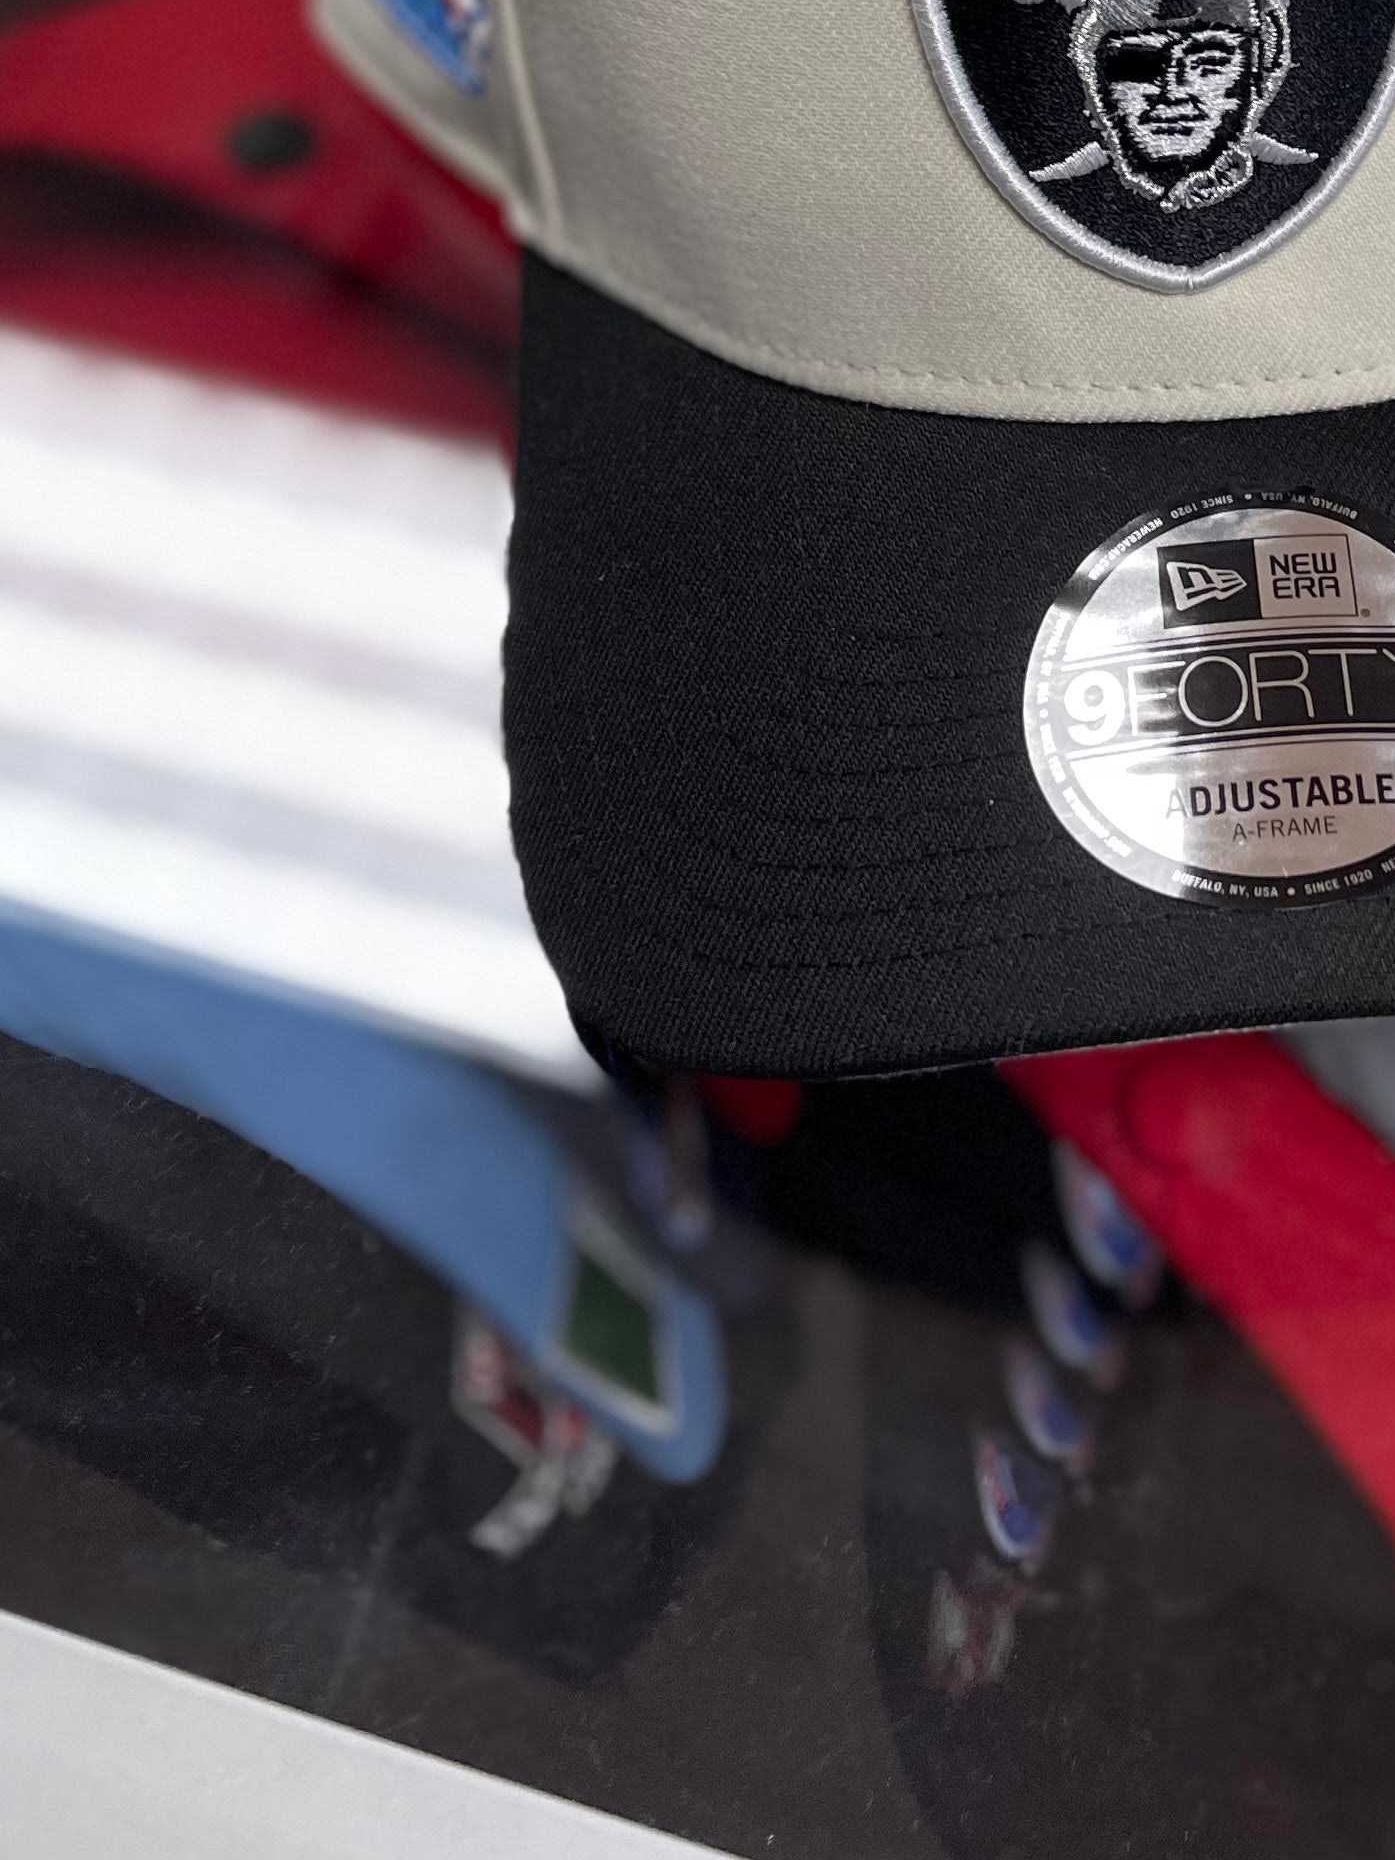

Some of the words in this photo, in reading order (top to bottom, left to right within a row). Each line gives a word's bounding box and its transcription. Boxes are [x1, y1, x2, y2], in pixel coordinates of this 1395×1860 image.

[1201, 494, 1234, 509] SINCE
[1260, 491, 1283, 501] USA
[1170, 503, 1199, 519] 1920
[1269, 553, 1338, 577] NEW
[1272, 576, 1341, 600] ERA
[1232, 815, 1338, 842] A-FRAME
[1254, 886, 1279, 897] USA
[1304, 878, 1340, 895] SINCE
[1343, 869, 1374, 886] 1920
